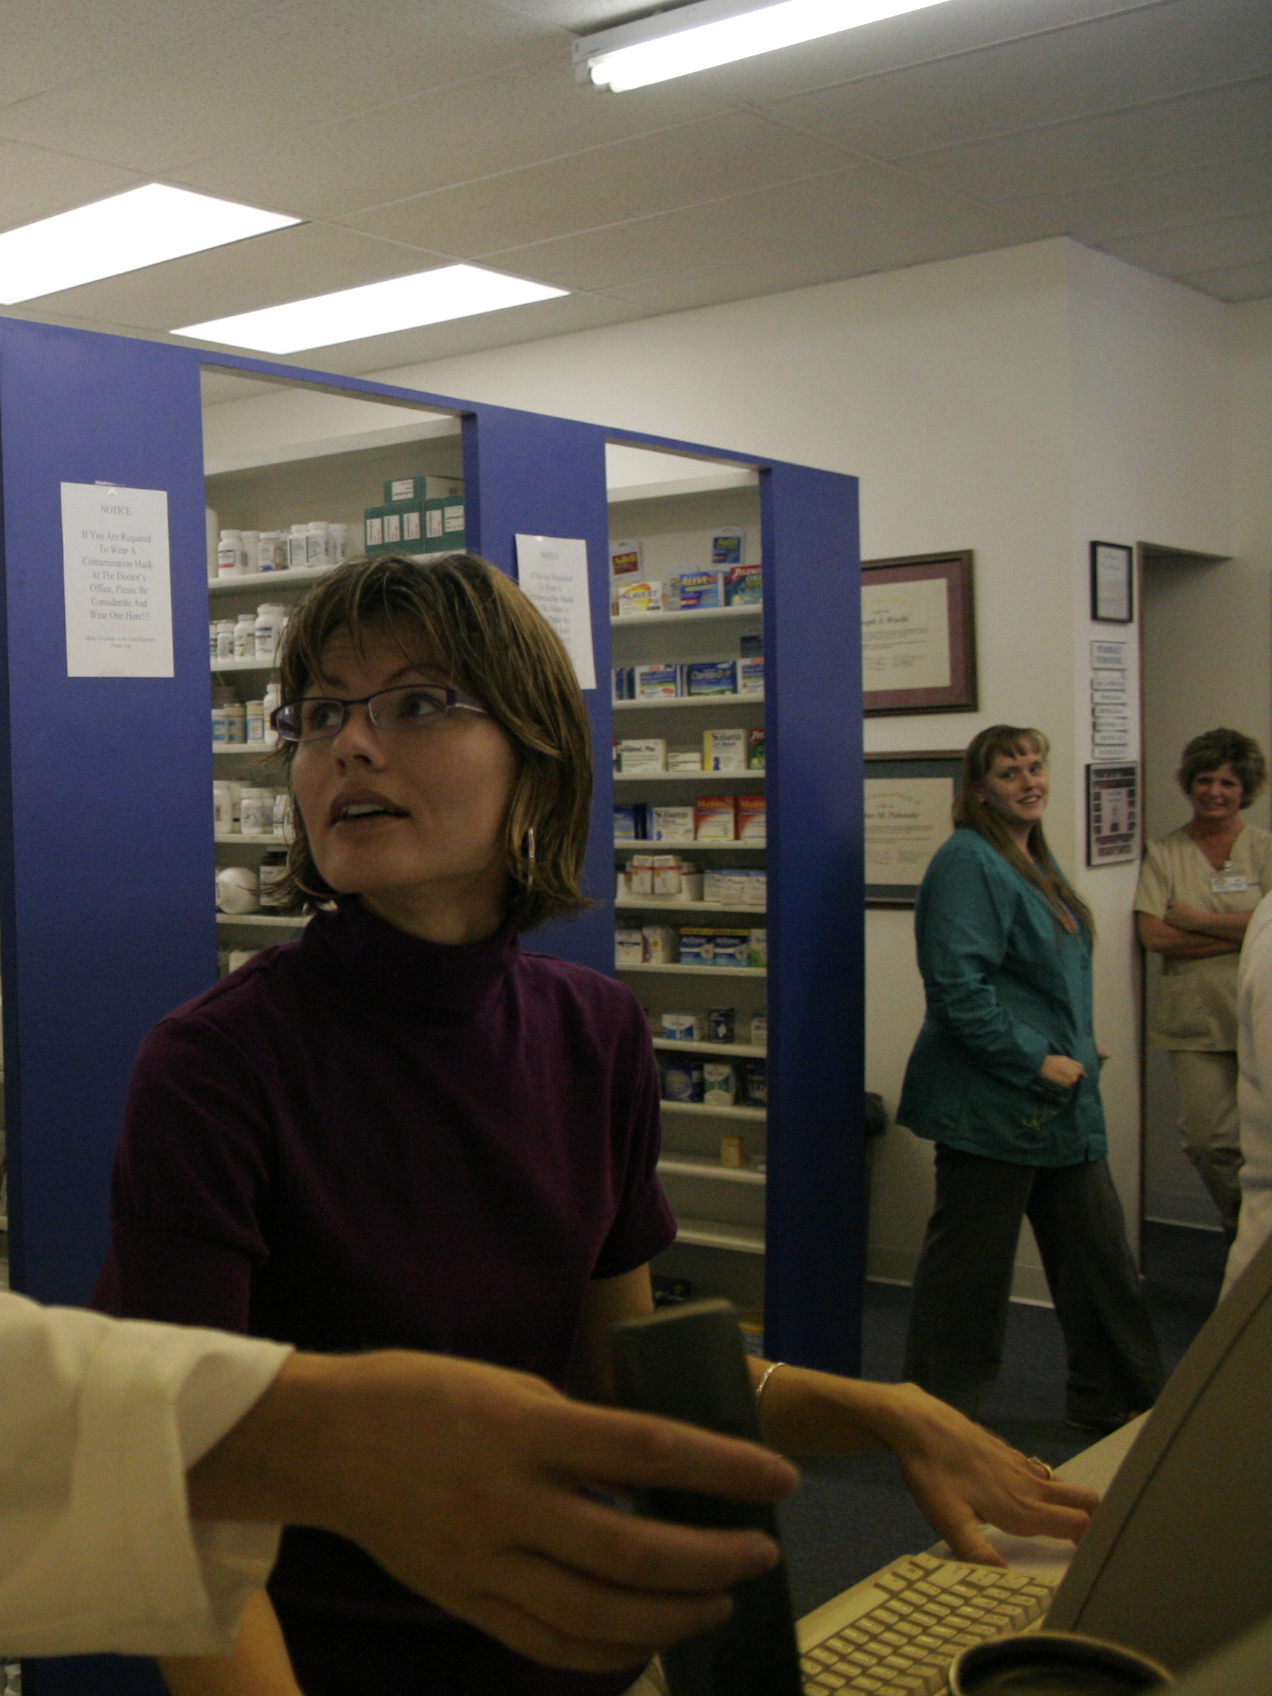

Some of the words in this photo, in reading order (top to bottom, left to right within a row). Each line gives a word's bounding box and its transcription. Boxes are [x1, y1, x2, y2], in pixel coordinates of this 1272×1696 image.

[101, 504, 132, 516] NOTICE
[81, 529, 89, 539] If
[90, 530, 105, 540] You
[107, 532, 119, 541] Are
[120, 532, 152, 544] Required
[99, 544, 108, 554] To
[110, 545, 129, 555] Wear
[82, 556, 133, 568] Contamination
[134, 560, 153, 569] Mask
[92, 571, 100, 580] At
[102, 571, 115, 580] The
[116, 572, 146, 582] Doctor's
[89, 583, 115, 595] Office,
[115, 585, 137, 594] Please
[138, 586, 148, 595] Be
[90, 597, 132, 607] Considerate
[134, 599, 148, 608] And
[89, 610, 108, 620] Wear
[109, 611, 124, 620] One
